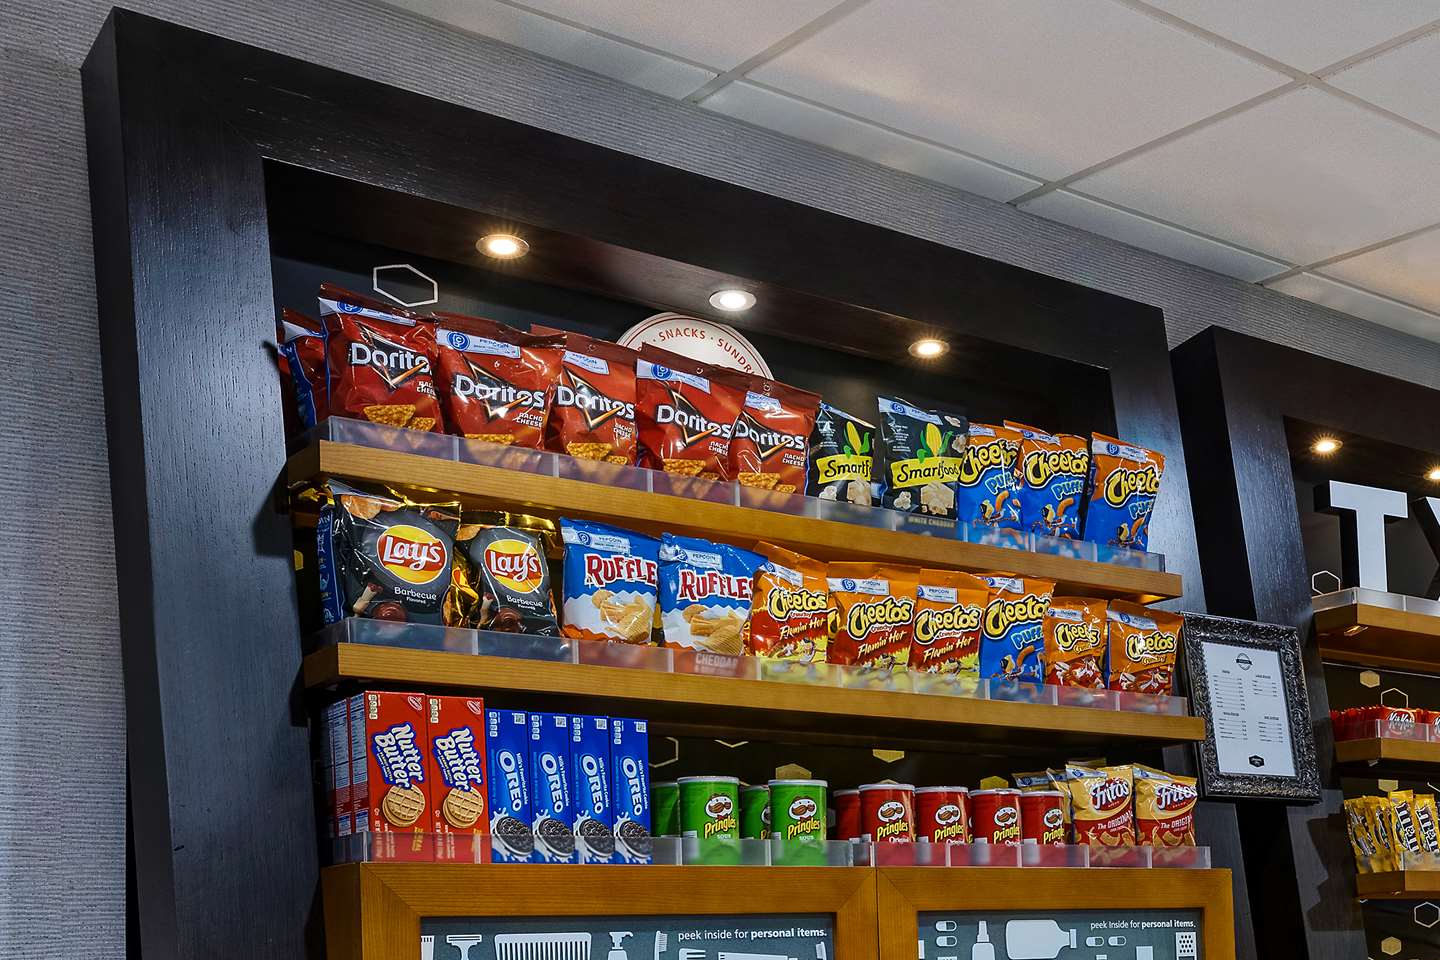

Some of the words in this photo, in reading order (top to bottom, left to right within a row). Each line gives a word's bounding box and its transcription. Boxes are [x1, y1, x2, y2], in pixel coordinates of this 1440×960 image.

[351, 342, 433, 376] Dorito
[658, 327, 706, 342] SNACKS
[717, 338, 755, 375] SUNDR
[456, 374, 545, 408] Doritos
[557, 385, 635, 420] Doritos
[656, 404, 732, 439] Doritos
[734, 420, 805, 450] Doritos
[824, 459, 872, 478] Smartf
[1025, 451, 1089, 487] Cheetos
[1106, 466, 1160, 507] Cheeto
[383, 537, 441, 571] Lay's
[490, 552, 538, 582] Lay's
[586, 555, 657, 587] RUFFLE
[394, 586, 437, 601] Barbecue
[506, 594, 543, 608] Barbecue
[769, 590, 827, 619] Cheetos
[808, 617, 826, 628] Hot
[850, 599, 912, 639] Cheetos
[915, 605, 981, 644] Cheetos
[888, 630, 907, 643] Hot
[956, 635, 975, 648] Hot
[1126, 632, 1176, 661] Cheetos
[374, 733, 410, 789] Butter
[391, 723, 424, 782] Nutter
[435, 736, 469, 792] Butter
[451, 727, 482, 785] Nutter
[500, 750, 522, 812] OREO
[541, 753, 564, 814] OREO
[582, 755, 604, 814] OREO
[622, 757, 643, 816] OREO
[1090, 780, 1130, 810] Fritos
[1155, 783, 1198, 810] Fritos
[704, 816, 736, 839] Pringles
[787, 817, 821, 840] Pringles
[877, 820, 909, 842] Pringles
[934, 822, 964, 843] Pringles
[993, 824, 1020, 845] Pringles
[1043, 827, 1065, 844] Pringle
[678, 929, 701, 942] peek
[704, 929, 732, 939] inside
[734, 929, 748, 939] for
[750, 928, 795, 940] personal
[797, 927, 827, 937] items.
[1090, 920, 1108, 931] peek
[1109, 920, 1129, 929] inside
[1129, 919, 1140, 928] for
[1141, 919, 1172, 930] personal
[1174, 919, 1196, 928] items.
